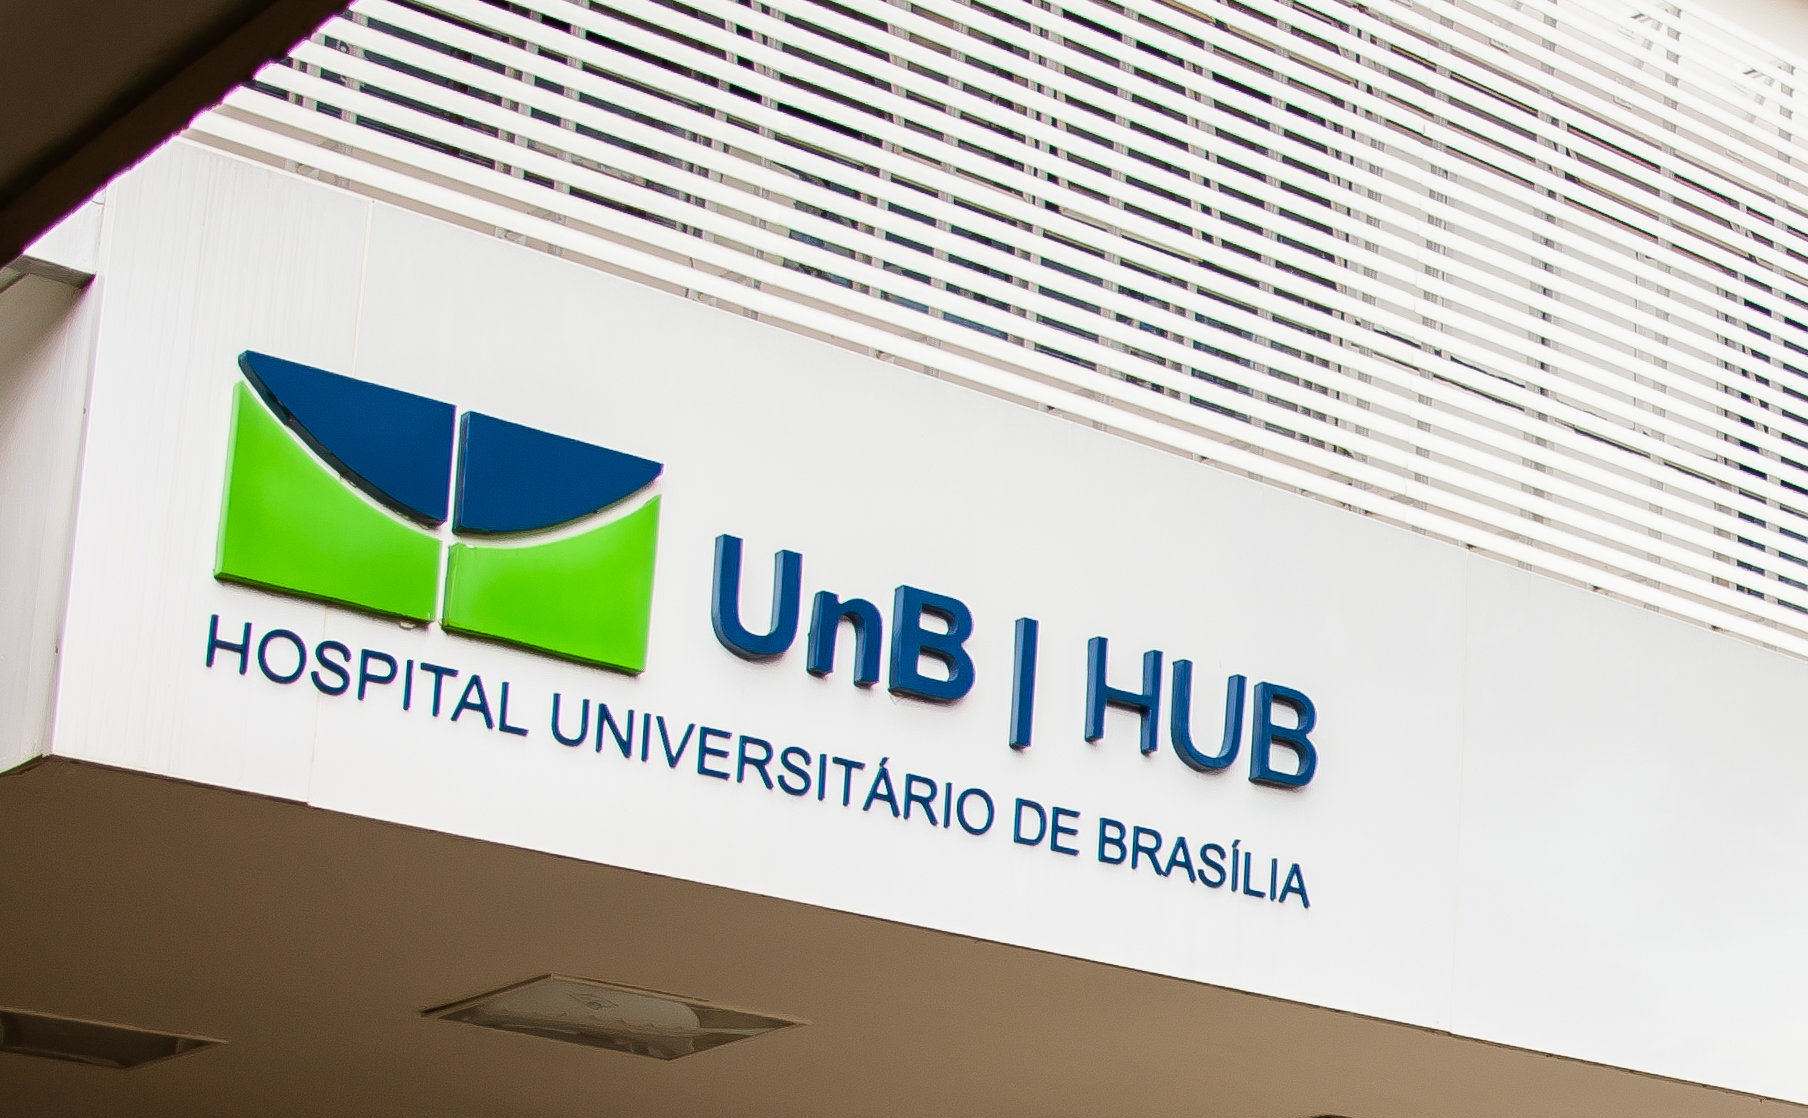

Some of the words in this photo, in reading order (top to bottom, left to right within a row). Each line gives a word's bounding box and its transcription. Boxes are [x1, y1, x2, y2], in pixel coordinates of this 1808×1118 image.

[205, 614, 529, 736] HOSPITAL
[550, 692, 995, 835] UNIVERSITÁRIO
[1013, 797, 1081, 856] DE
[1097, 817, 1310, 909] BRASÍLIA
[711, 533, 976, 702] UnB
[1083, 635, 1318, 790] HUB
